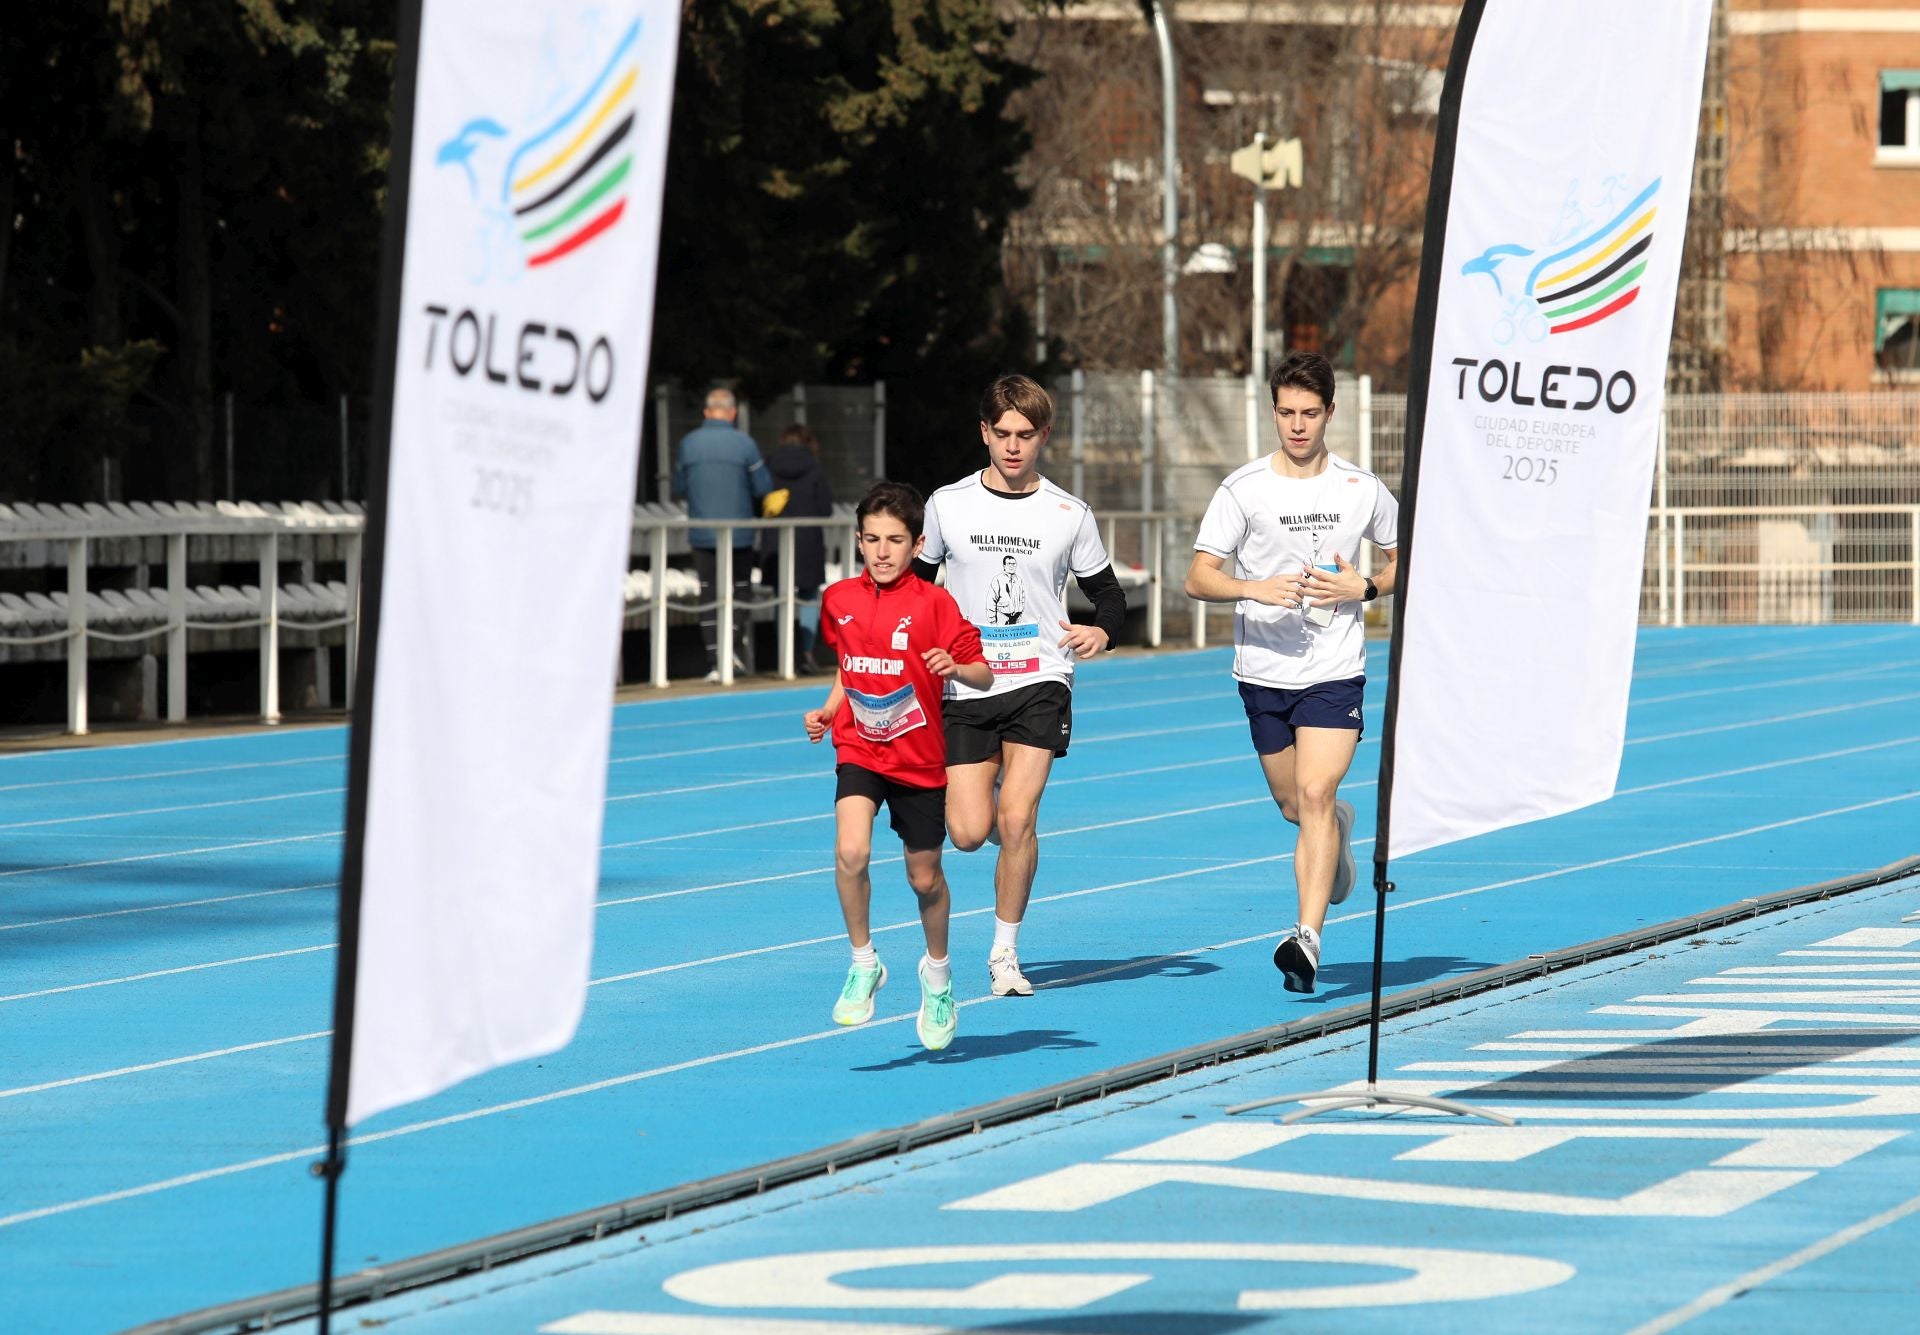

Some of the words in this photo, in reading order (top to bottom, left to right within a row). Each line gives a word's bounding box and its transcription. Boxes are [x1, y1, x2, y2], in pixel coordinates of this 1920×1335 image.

[424, 303, 615, 404] TOLEDO
[1451, 357, 1636, 414] TOLEDO
[1474, 415, 1528, 431] CIUDAD
[1533, 420, 1596, 439] EUROPEA
[1486, 433, 1511, 448] DEL
[1516, 436, 1581, 454] DEPORTE
[1502, 455, 1559, 487] 2025
[1279, 516, 1302, 525] MILLA
[970, 534, 995, 545] MILLA
[997, 535, 1041, 550] HOMENAJE
[1004, 547, 1033, 556] VELASCO
[999, 640, 1031, 648] VELASCO
[998, 652, 1011, 660] 62
[875, 719, 890, 728] 40
